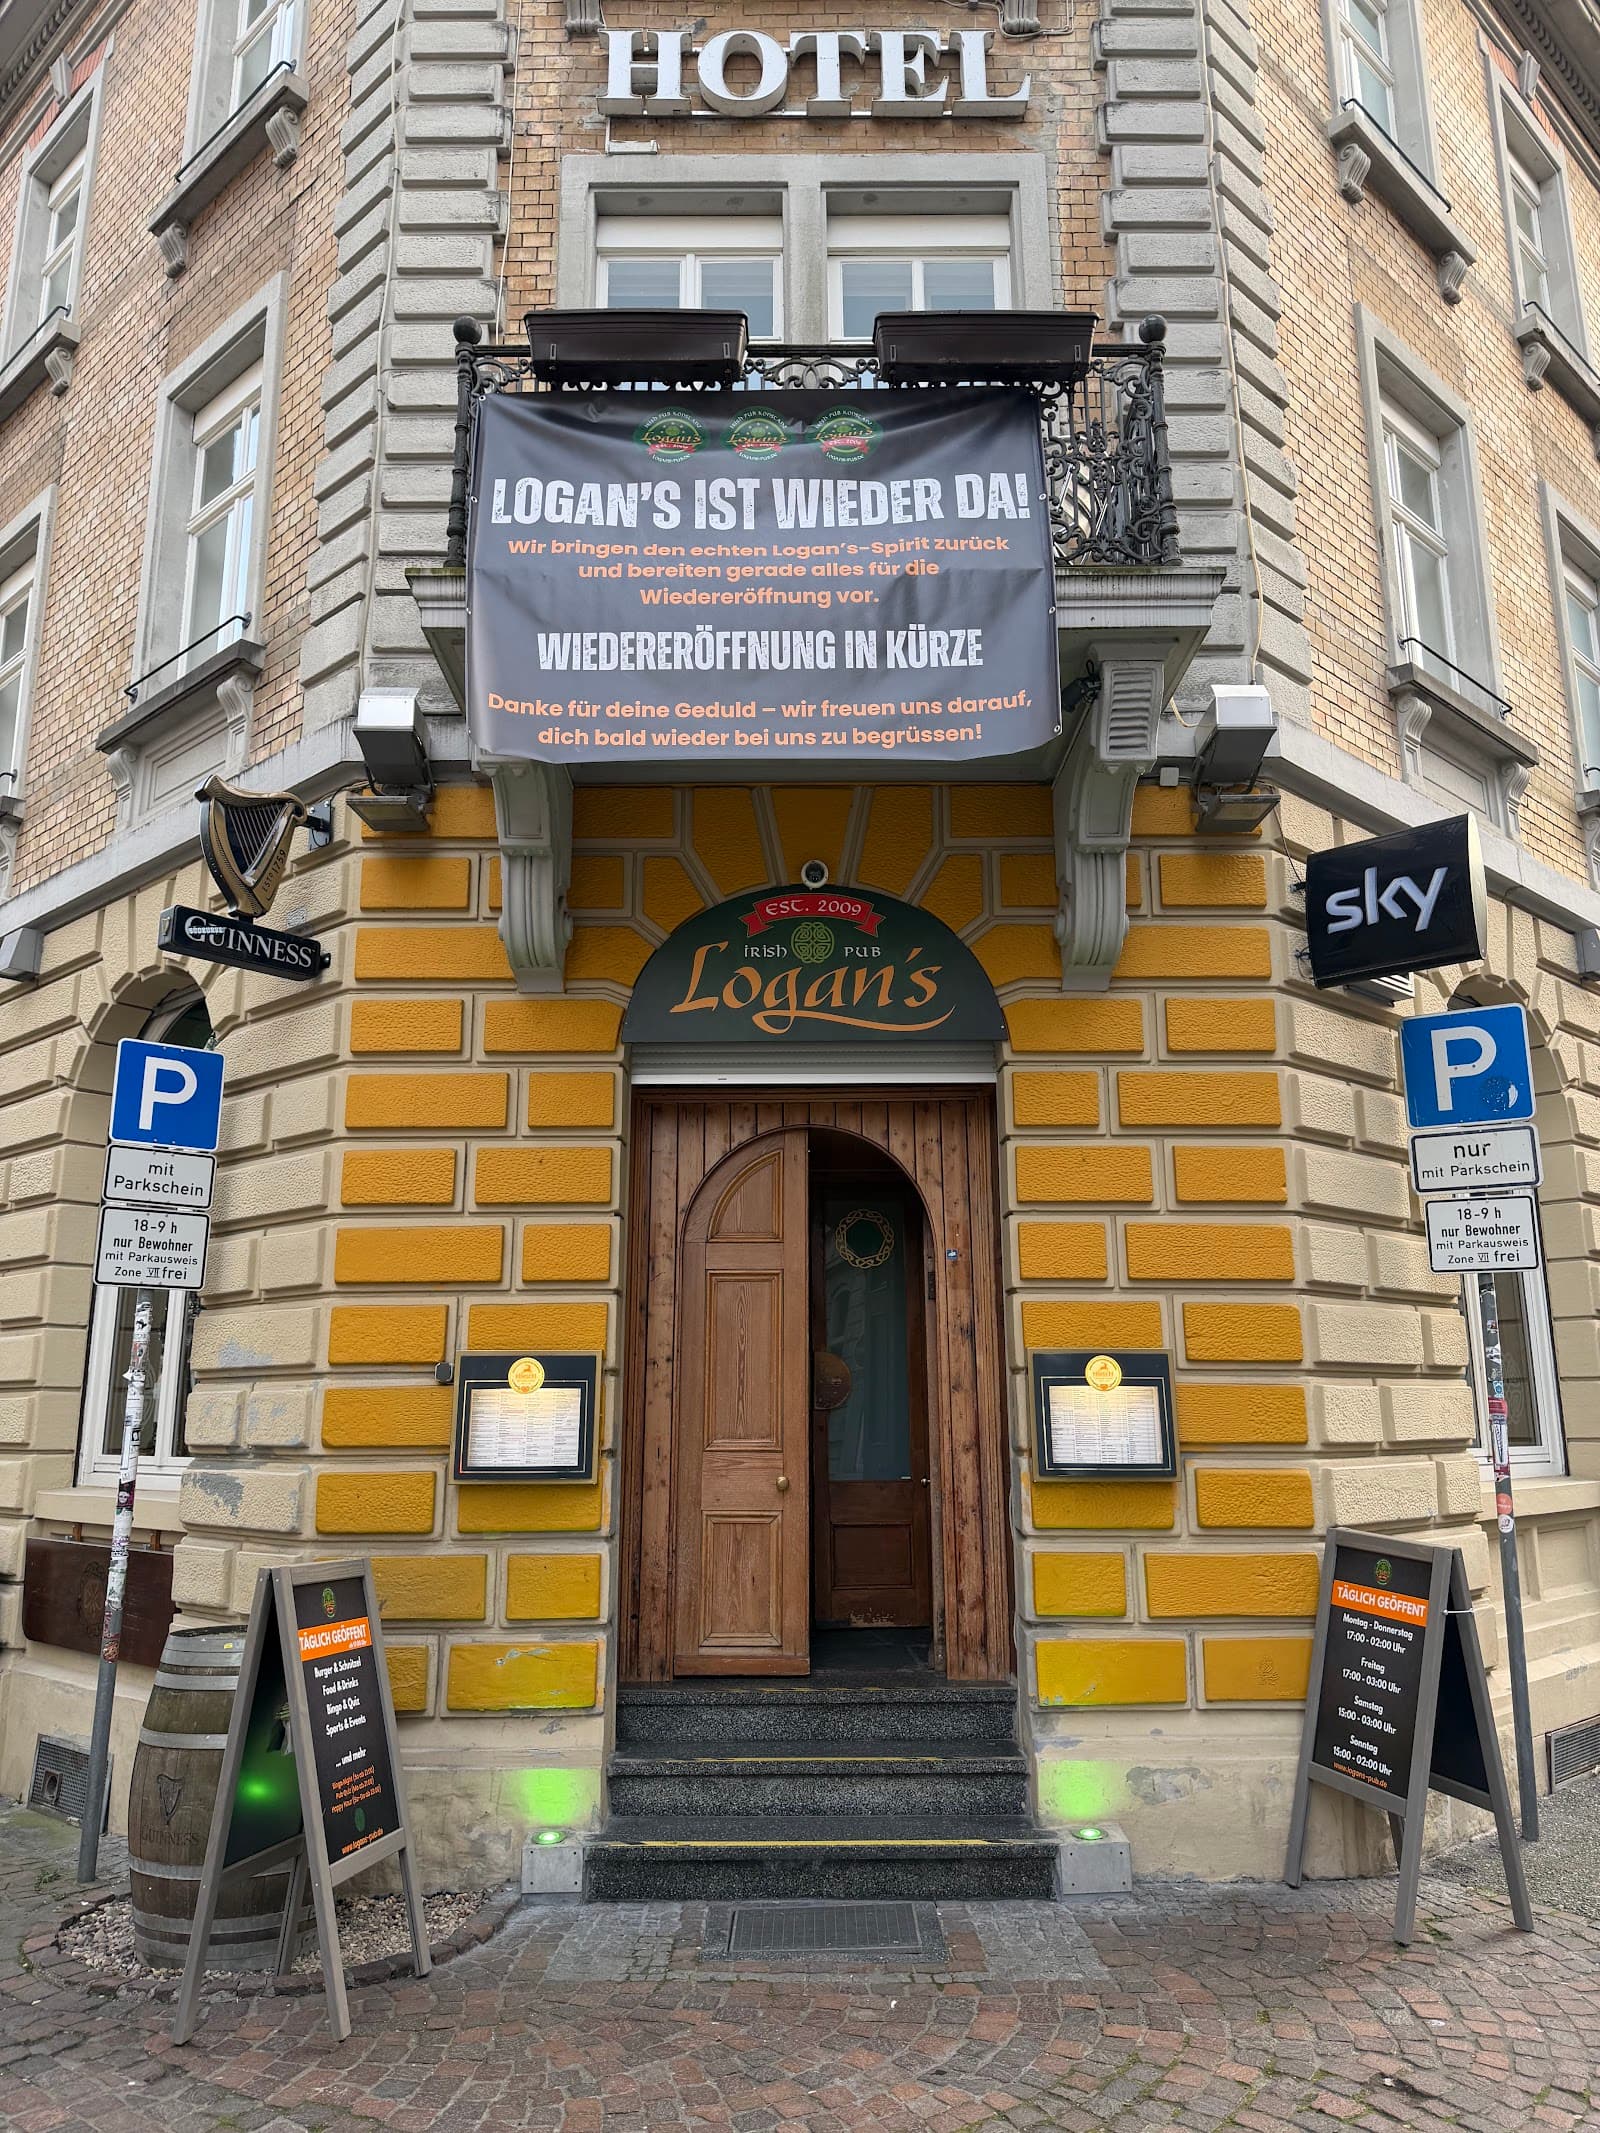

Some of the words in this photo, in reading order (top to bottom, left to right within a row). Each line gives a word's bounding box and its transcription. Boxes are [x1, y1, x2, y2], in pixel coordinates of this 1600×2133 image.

[597, 30, 1031, 114] HOTEL
[491, 477, 681, 529] LOGAN'S
[694, 478, 761, 531] IST
[771, 478, 945, 530] WIEDER
[955, 473, 1031, 519] DA!
[508, 540, 546, 554] Wir
[551, 539, 638, 559] bringen
[643, 543, 687, 556] den
[690, 544, 767, 557] echten
[934, 536, 1009, 551] zurück
[578, 563, 622, 578] und
[627, 563, 721, 578] bereiten
[726, 563, 807, 582] gerade
[811, 563, 864, 577] alles
[868, 561, 900, 576] für
[905, 559, 940, 576] die
[640, 588, 832, 609] Wiedereröffnung
[836, 589, 880, 604] vor.
[537, 624, 836, 671] WIEDERERÖFFNUNG
[845, 630, 877, 669] IN
[886, 623, 984, 669] KÜRZE
[487, 693, 563, 717] Danke
[568, 700, 600, 718] für
[605, 701, 669, 718] deine
[675, 701, 756, 718] Geduld
[781, 700, 816, 718] wir
[821, 700, 896, 717] freuen
[900, 699, 942, 715] uns
[947, 689, 1032, 714] darauf,
[538, 727, 589, 745] dich
[595, 729, 646, 746] bald
[651, 729, 729, 746] wieder
[734, 729, 769, 746] bei
[775, 731, 816, 745] uns
[821, 731, 847, 745] zu
[853, 724, 982, 750] begrüssen!
[765, 900, 810, 916] EST.
[817, 899, 862, 917] 2009
[1326, 866, 1449, 934] sky
[185, 915, 312, 968] GUINNESS
[844, 945, 881, 958] PUB
[670, 941, 956, 1034] Logan's
[1430, 1025, 1497, 1111] P
[138, 1056, 197, 1130] P
[1453, 1142, 1491, 1158] nur
[148, 1162, 174, 1177] mit
[1422, 1165, 1444, 1179] mit
[1450, 1160, 1530, 1177] Parkschein
[114, 1175, 204, 1197] Parkschein
[1494, 1207, 1502, 1219] h
[170, 1220, 178, 1234] h
[1441, 1227, 1460, 1238] nur
[1465, 1223, 1521, 1237] Bewohner
[113, 1237, 133, 1249] nur
[138, 1237, 194, 1252] Bewohner
[1436, 1240, 1453, 1250] mit
[1458, 1238, 1529, 1250] Parkausweis
[105, 1252, 124, 1261] mit
[128, 1252, 198, 1266] Parkausweis
[1448, 1254, 1474, 1264] Zone
[1477, 1252, 1490, 1263] VII
[1494, 1250, 1520, 1263] frei
[114, 1266, 142, 1278] Zone
[162, 1266, 188, 1280] frei
[1337, 1585, 1376, 1606] TÄGLICH
[1377, 1594, 1426, 1617] GEÖFFENT
[299, 1632, 331, 1651] TÄGLICH
[332, 1624, 366, 1644] GEÖFFENT
[1343, 1612, 1368, 1630] Montag
[1374, 1621, 1413, 1641] Donnerstag
[1346, 1630, 1365, 1643] 17:00
[1370, 1636, 1392, 1650] 02:00
[1392, 1641, 1406, 1654] Uhr
[314, 1666, 333, 1679] Burger
[338, 1656, 361, 1672] Schnitzel
[1361, 1657, 1385, 1674] Freitag
[322, 1682, 336, 1696] Food
[341, 1677, 359, 1690] Drinks
[1342, 1668, 1361, 1682] 17:00
[1366, 1675, 1387, 1689] 03:00
[1388, 1681, 1401, 1694] Uhr
[1354, 1695, 1383, 1715] Samstag
[326, 1722, 344, 1738] Sports
[349, 1715, 366, 1728] Events
[1338, 1707, 1356, 1720] 15:00
[1361, 1715, 1382, 1730] 03:00
[1383, 1721, 1397, 1734] Uhr
[1350, 1735, 1378, 1755] Sonntag
[1333, 1746, 1351, 1760] 15:00
[1356, 1755, 1378, 1770] 02:00
[1379, 1763, 1392, 1776] Uhr
